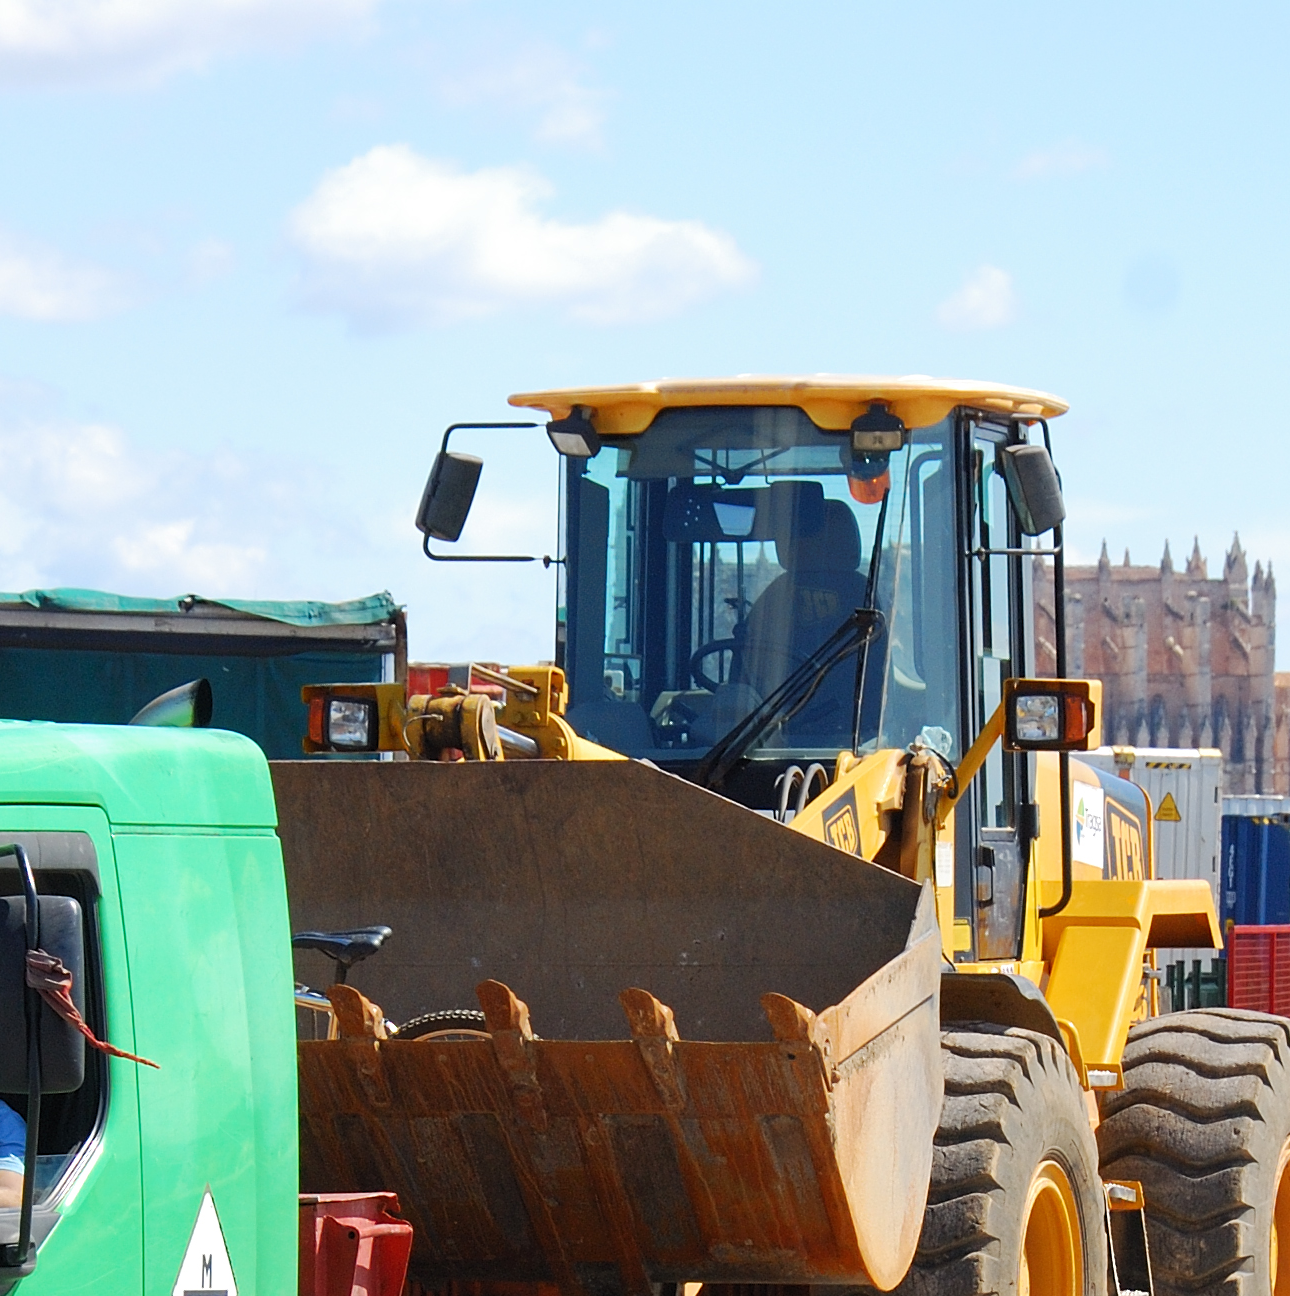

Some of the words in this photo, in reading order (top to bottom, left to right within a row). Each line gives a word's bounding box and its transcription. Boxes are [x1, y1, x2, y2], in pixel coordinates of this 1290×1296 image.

[828, 808, 856, 853] JCB
[1084, 807, 1103, 838] Tragsa
[1111, 813, 1143, 880] JCB
[200, 1253, 213, 1289] M
